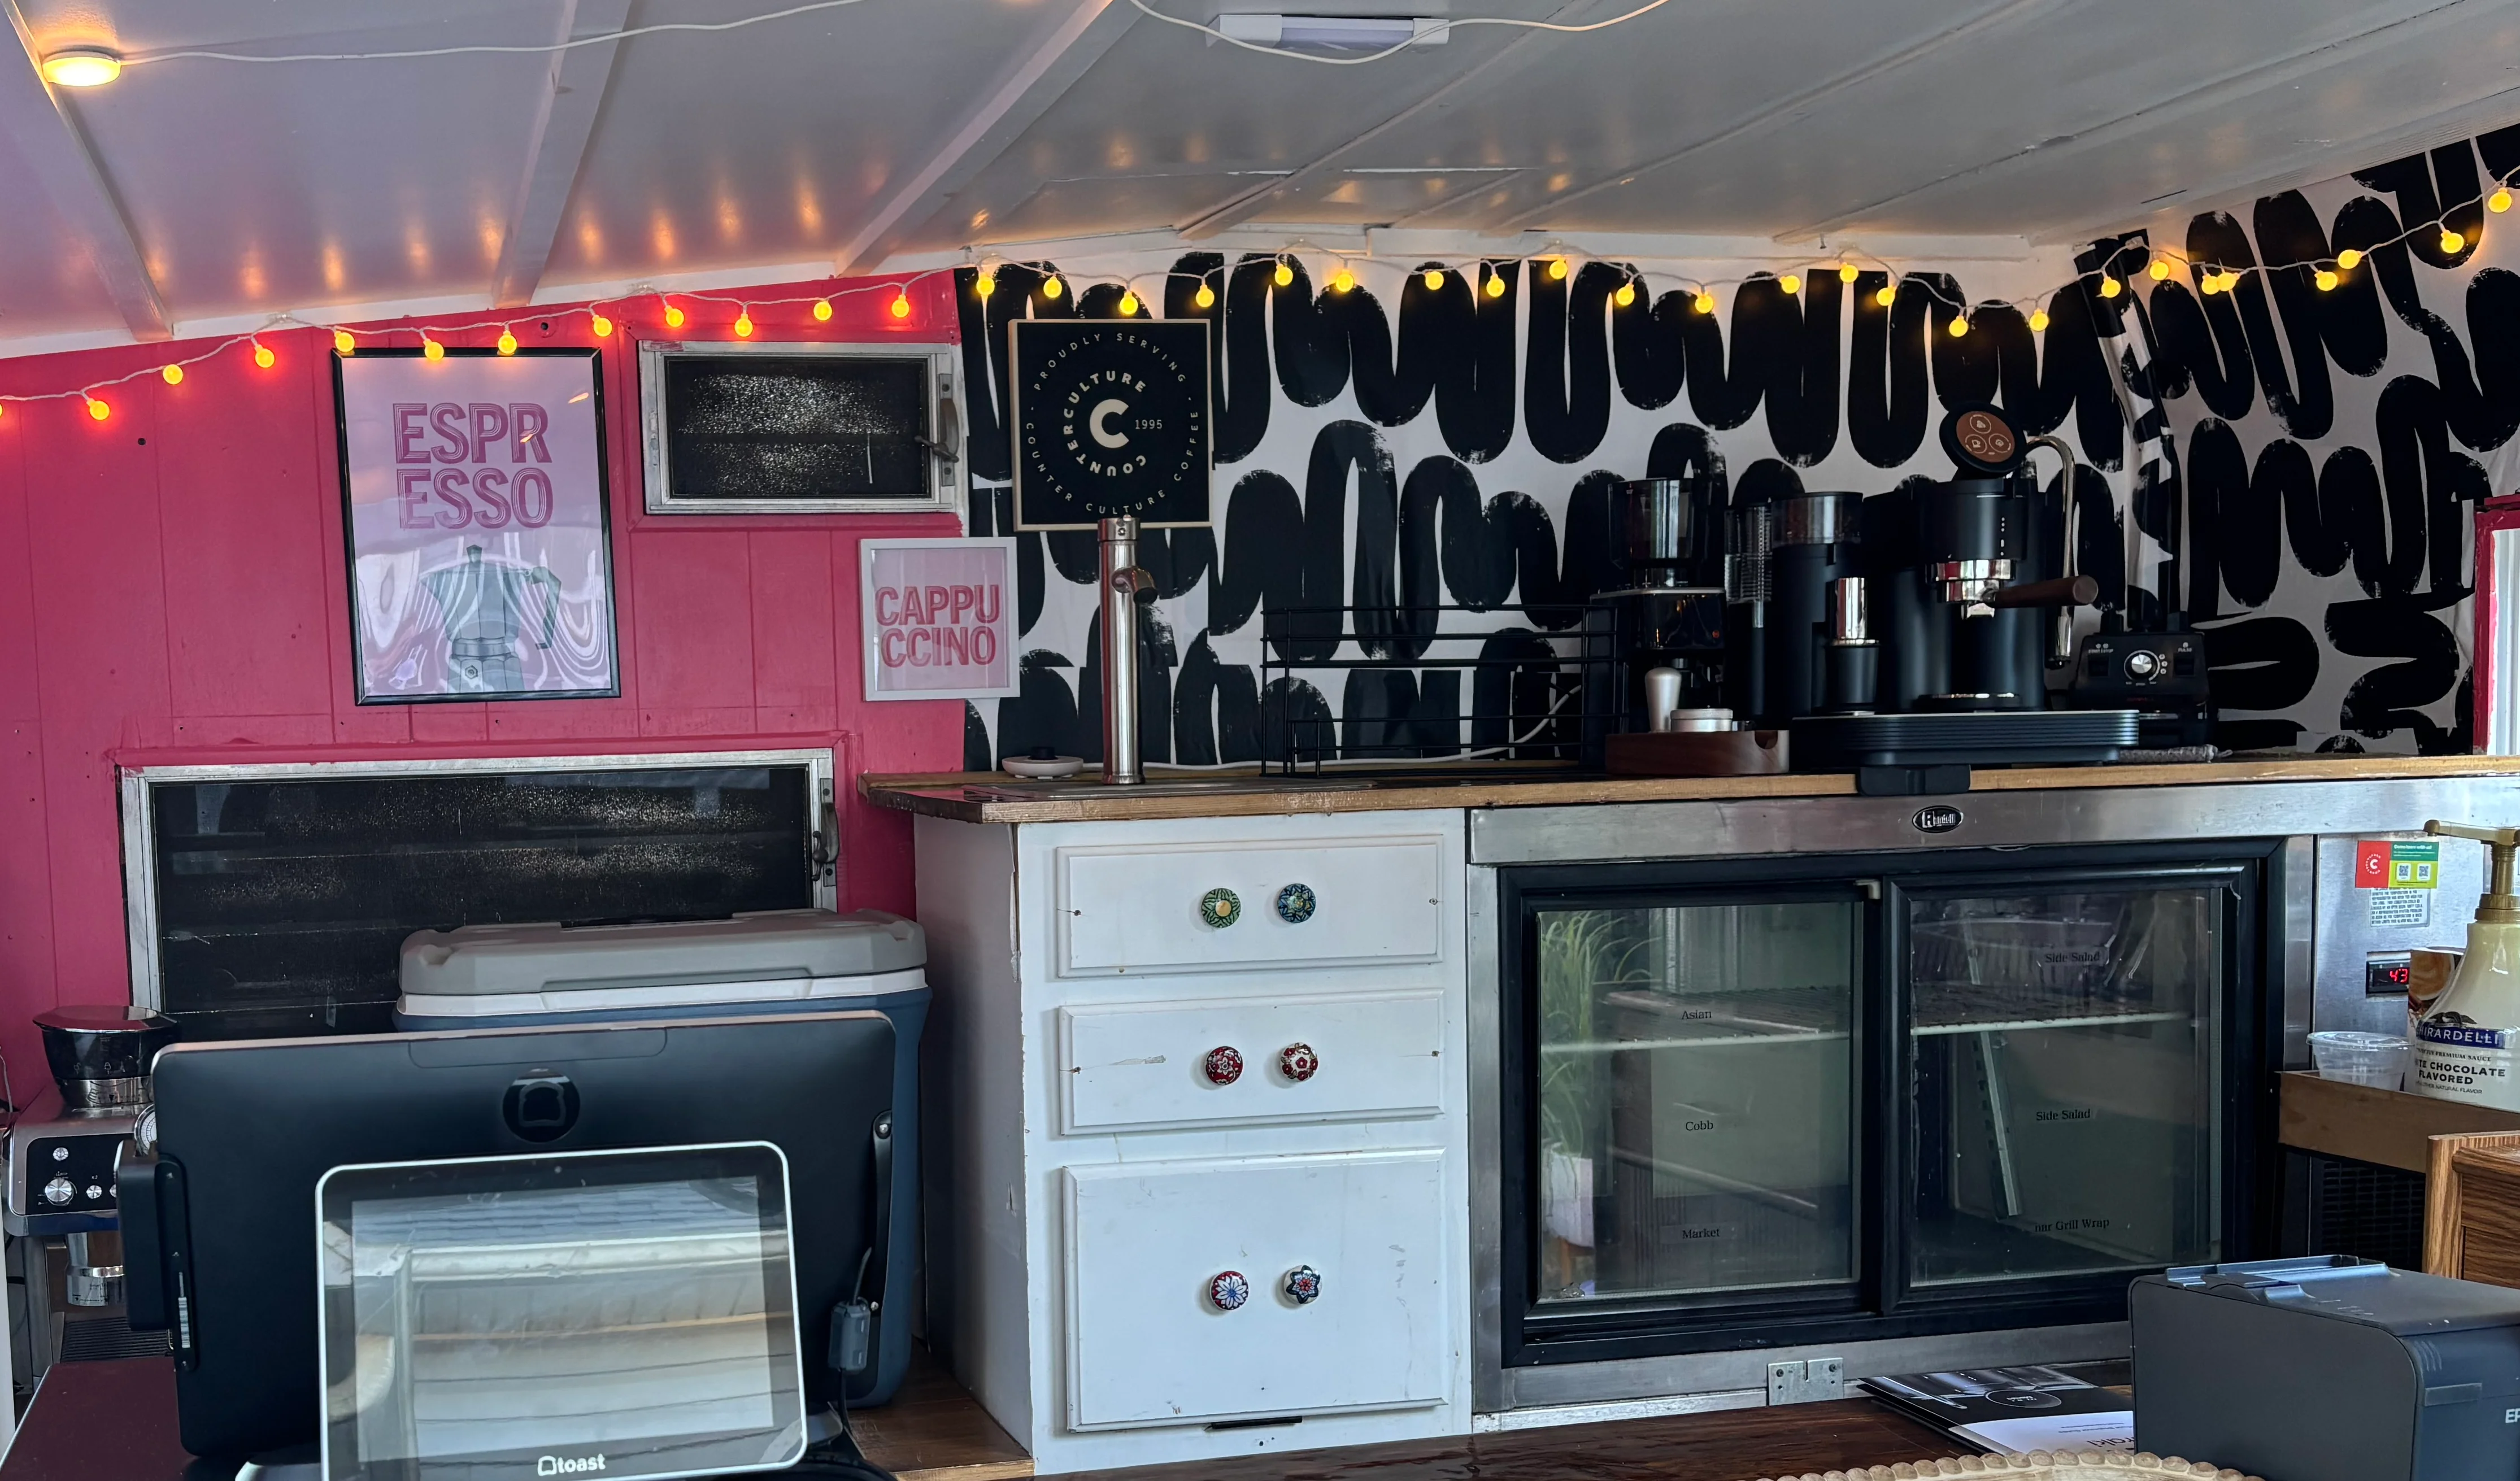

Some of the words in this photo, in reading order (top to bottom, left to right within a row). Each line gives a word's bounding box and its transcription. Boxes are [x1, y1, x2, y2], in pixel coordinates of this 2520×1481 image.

[1034, 333, 1101, 391] PROUDLY
[1116, 333, 1186, 383] SERVING
[1089, 398, 1130, 449] C
[1134, 419, 1163, 430] 1995
[393, 402, 552, 464] ESPR
[1026, 422, 1073, 502] COUNTER
[1086, 490, 1165, 515] CULTURE
[1174, 411, 1199, 481] COFFEE
[396, 468, 554, 529] ESSO
[875, 584, 1000, 626] CAPPU
[881, 626, 996, 668] CCINO
[2045, 952, 2068, 963] Side
[2071, 951, 2100, 962] Salad
[2390, 968, 2408, 983] 43
[1682, 1009, 1712, 1020] Asian
[2435, 1051, 2466, 1060] PREMIUM
[2418, 1069, 2474, 1085] FLAVORED
[2430, 1061, 2506, 1078] CHOCOLATE
[2036, 1110, 2058, 1121] Side
[2061, 1108, 2091, 1120] Salad
[1685, 1120, 1714, 1131] Cobb
[2056, 1219, 2079, 1231] Grill
[2082, 1218, 2110, 1229] Wrap
[1682, 1228, 1720, 1239] Market
[557, 1453, 606, 1474] toast
